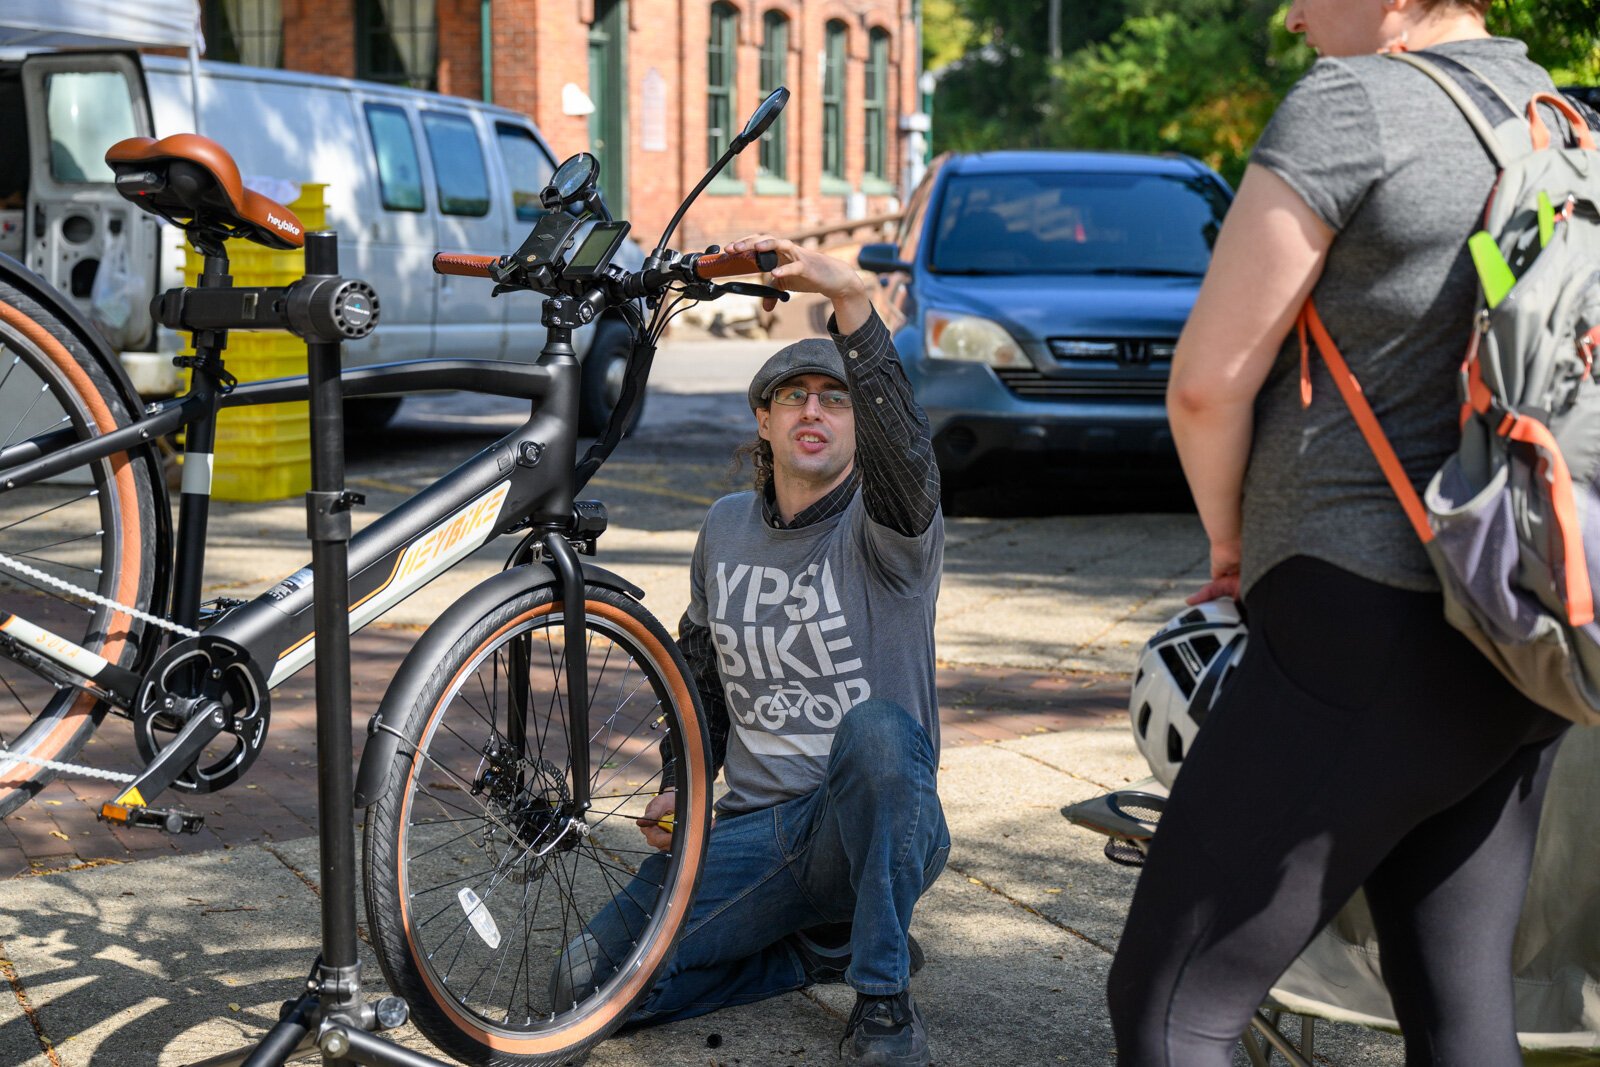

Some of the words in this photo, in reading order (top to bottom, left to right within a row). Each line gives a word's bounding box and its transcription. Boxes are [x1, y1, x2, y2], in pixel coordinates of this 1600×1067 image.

[267, 212, 300, 236] heybike
[715, 557, 842, 623] YPSI
[710, 614, 863, 681] BIKE
